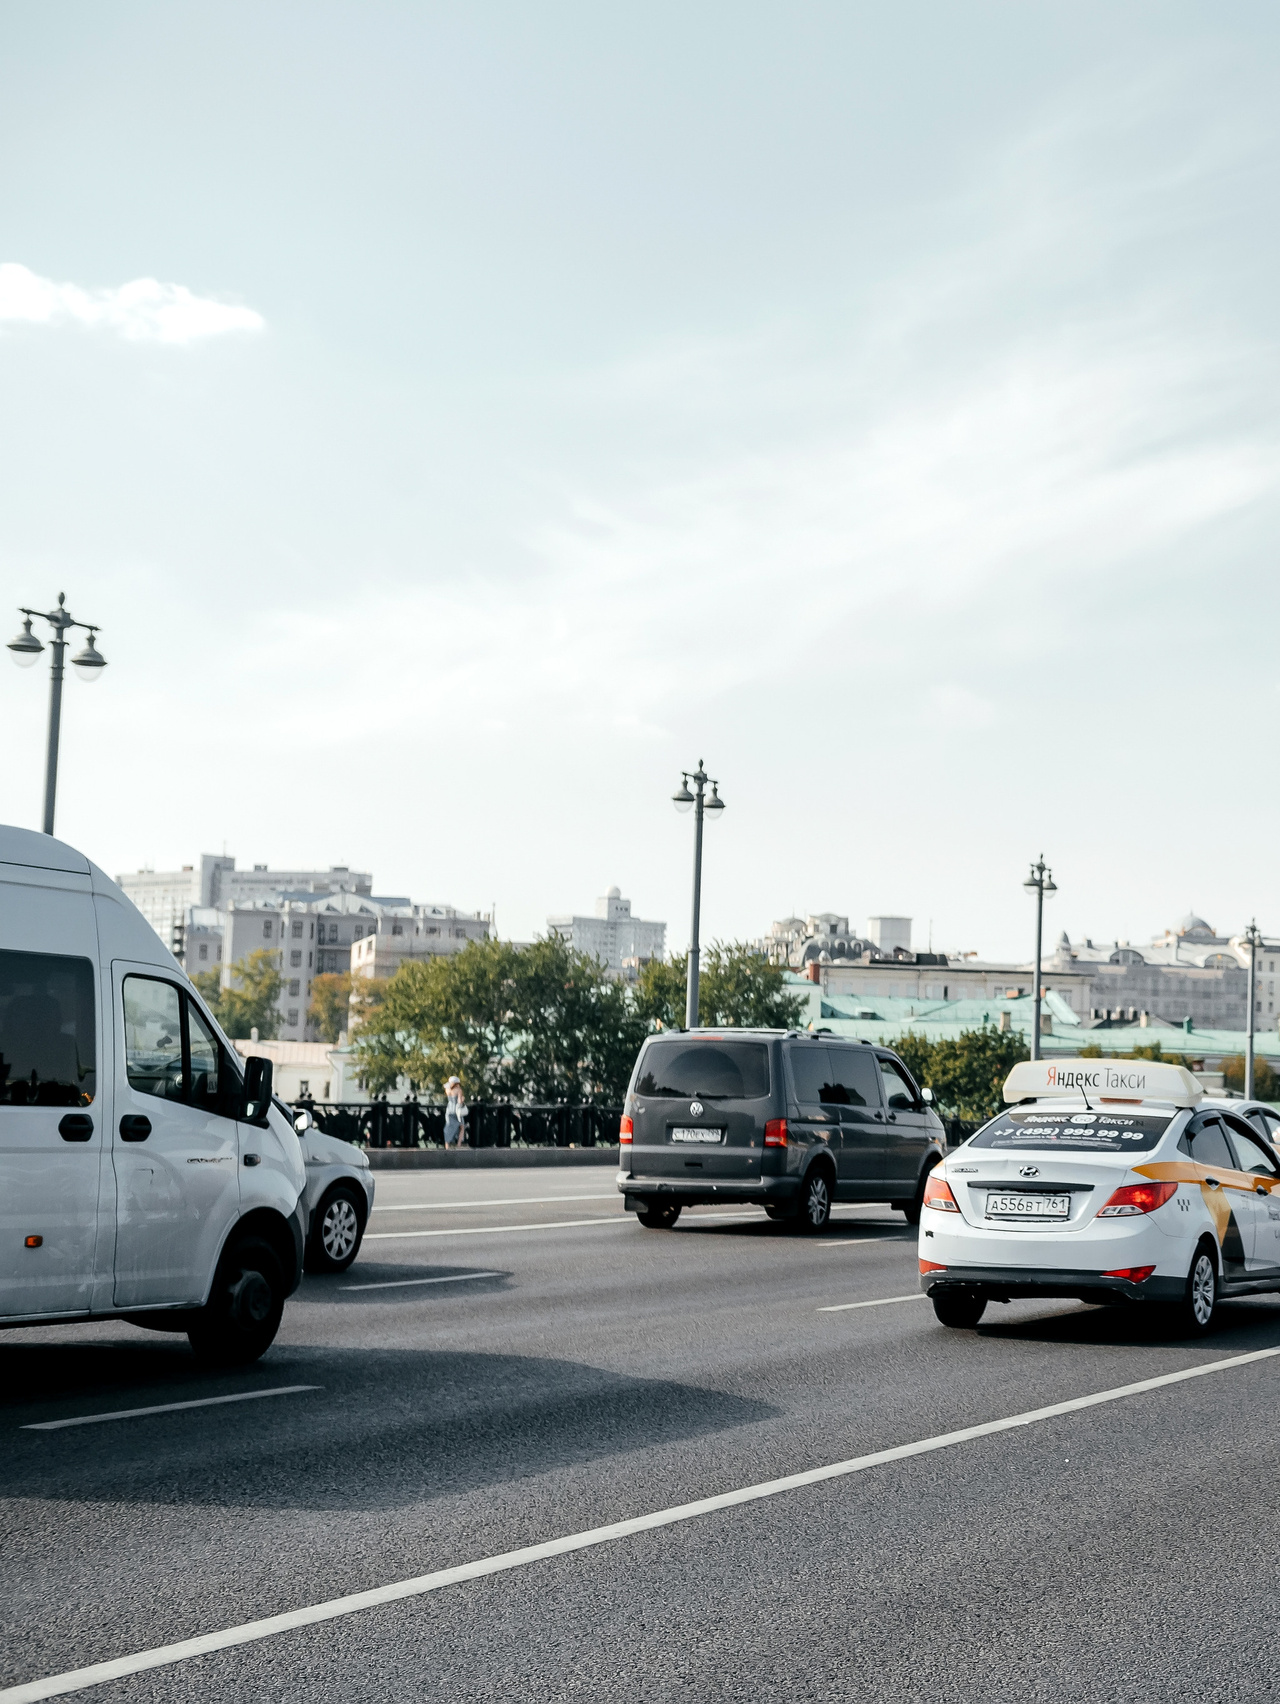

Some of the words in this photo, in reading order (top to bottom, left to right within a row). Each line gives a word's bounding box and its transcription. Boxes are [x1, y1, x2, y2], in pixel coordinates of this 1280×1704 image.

[1046, 1066, 1100, 1088] Яндекс
[1104, 1067, 1146, 1089] Такси
[1098, 1116, 1135, 1126] Такси
[993, 1128, 1015, 1136] +7
[1016, 1127, 1060, 1136] (495)
[1062, 1127, 1095, 1136] 999
[1096, 1129, 1119, 1138] 99
[1121, 1131, 1144, 1140] 99
[990, 1197, 1043, 1212] А556ВТ
[1045, 1198, 1066, 1210] 761
